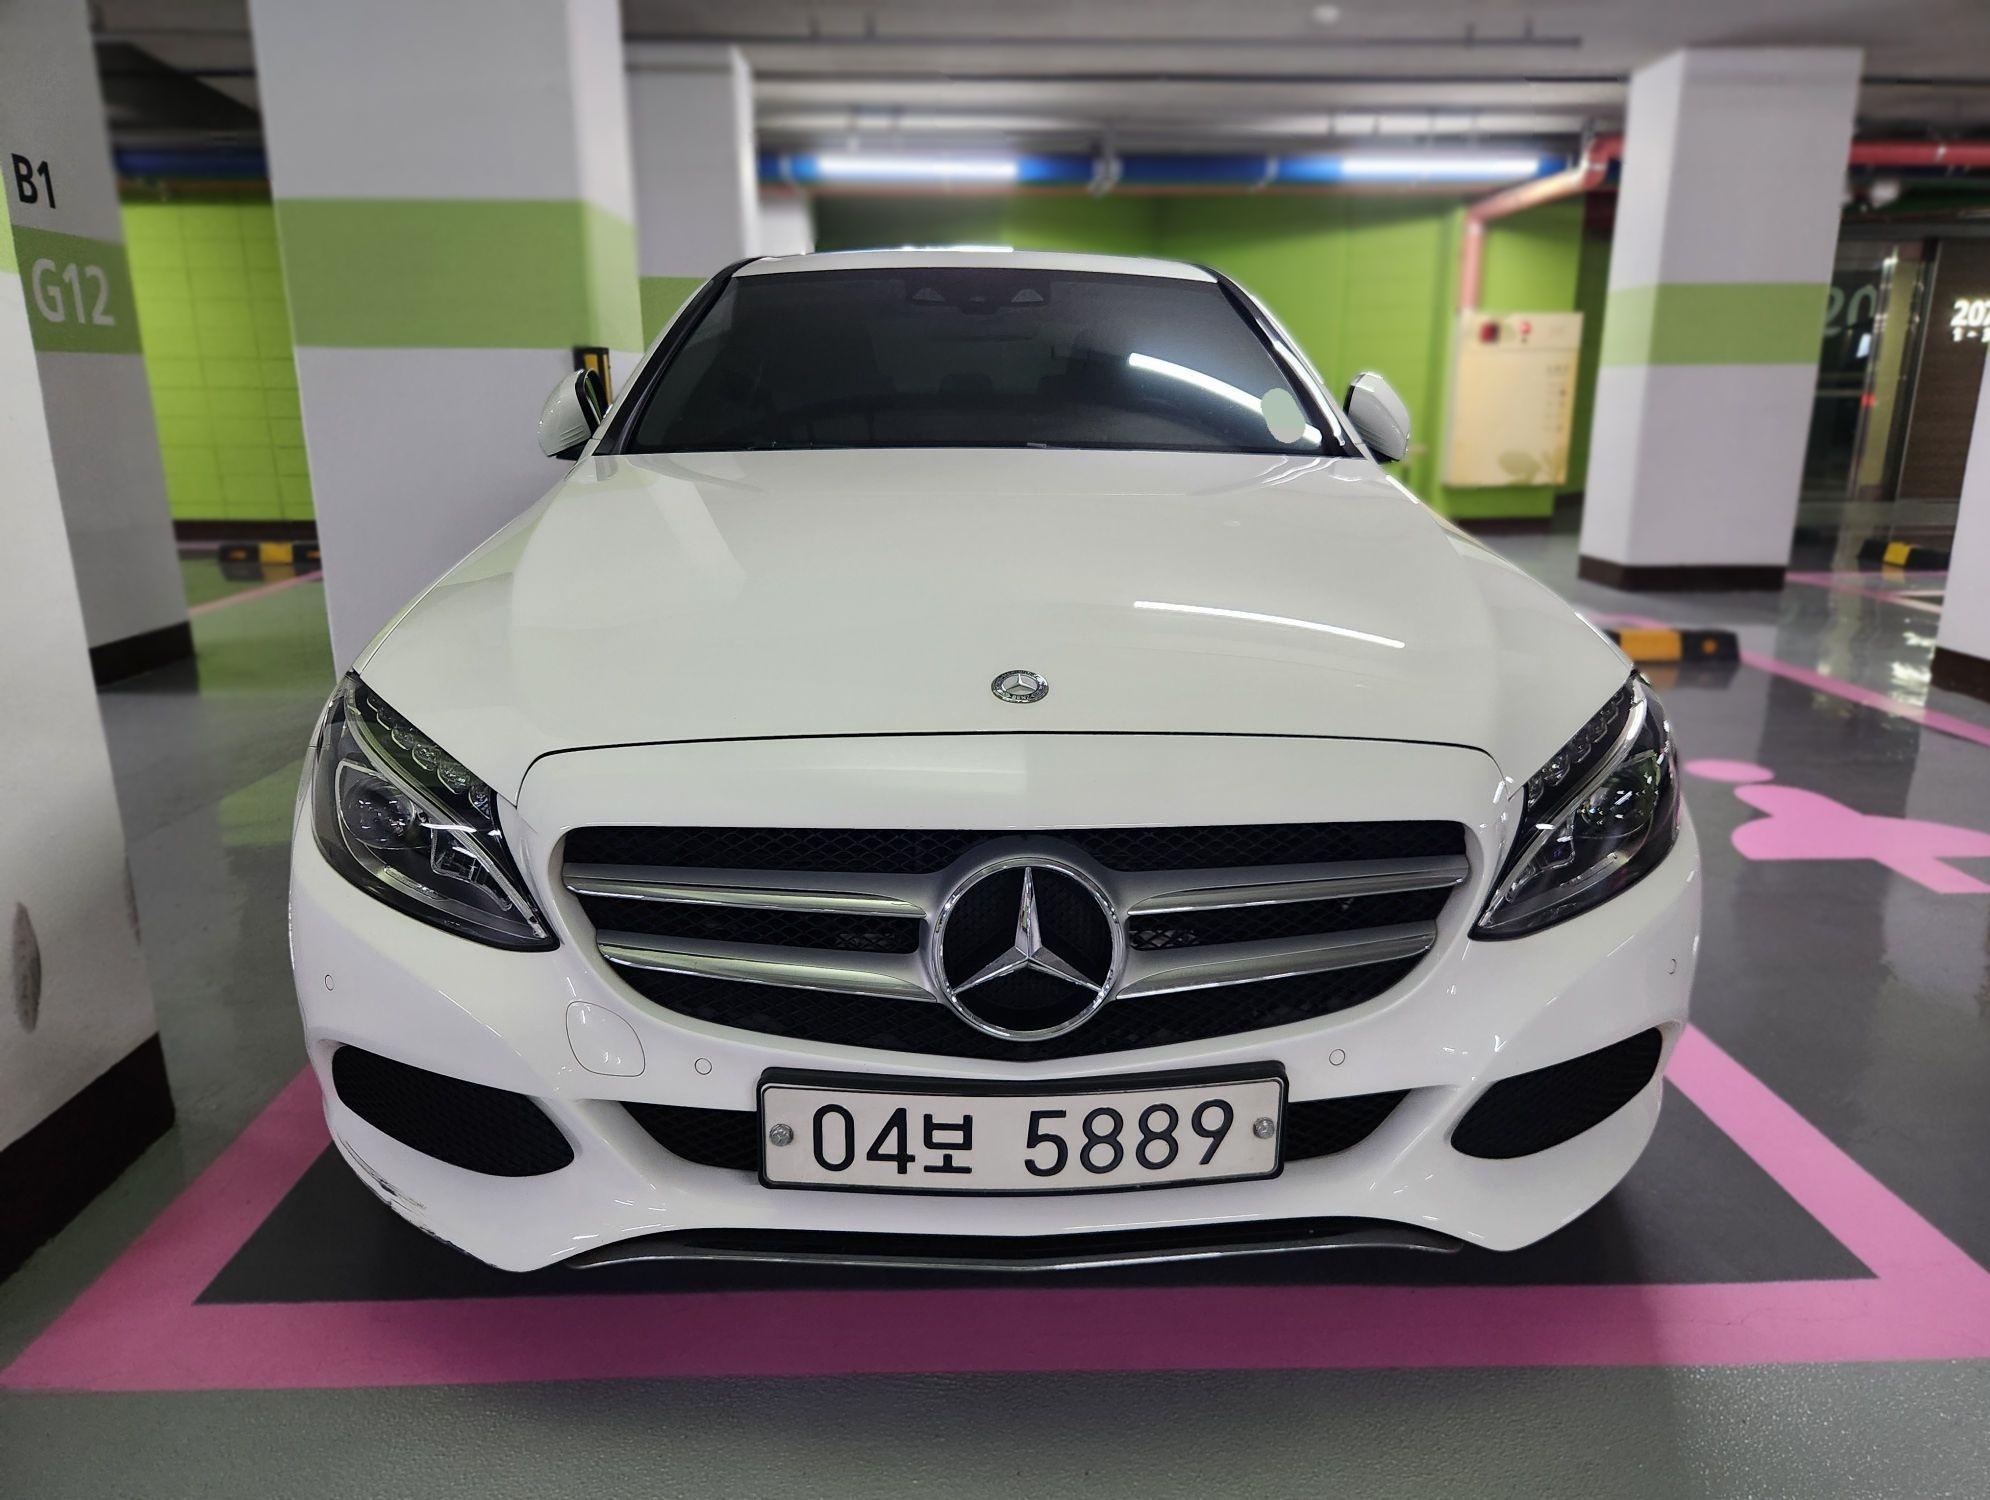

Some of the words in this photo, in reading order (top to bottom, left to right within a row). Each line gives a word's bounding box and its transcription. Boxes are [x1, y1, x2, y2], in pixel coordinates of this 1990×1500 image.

[11, 153, 56, 209] B1
[32, 258, 116, 326] G12
[812, 1103, 973, 1175] 04보
[1024, 1098, 1234, 1177] 5889
